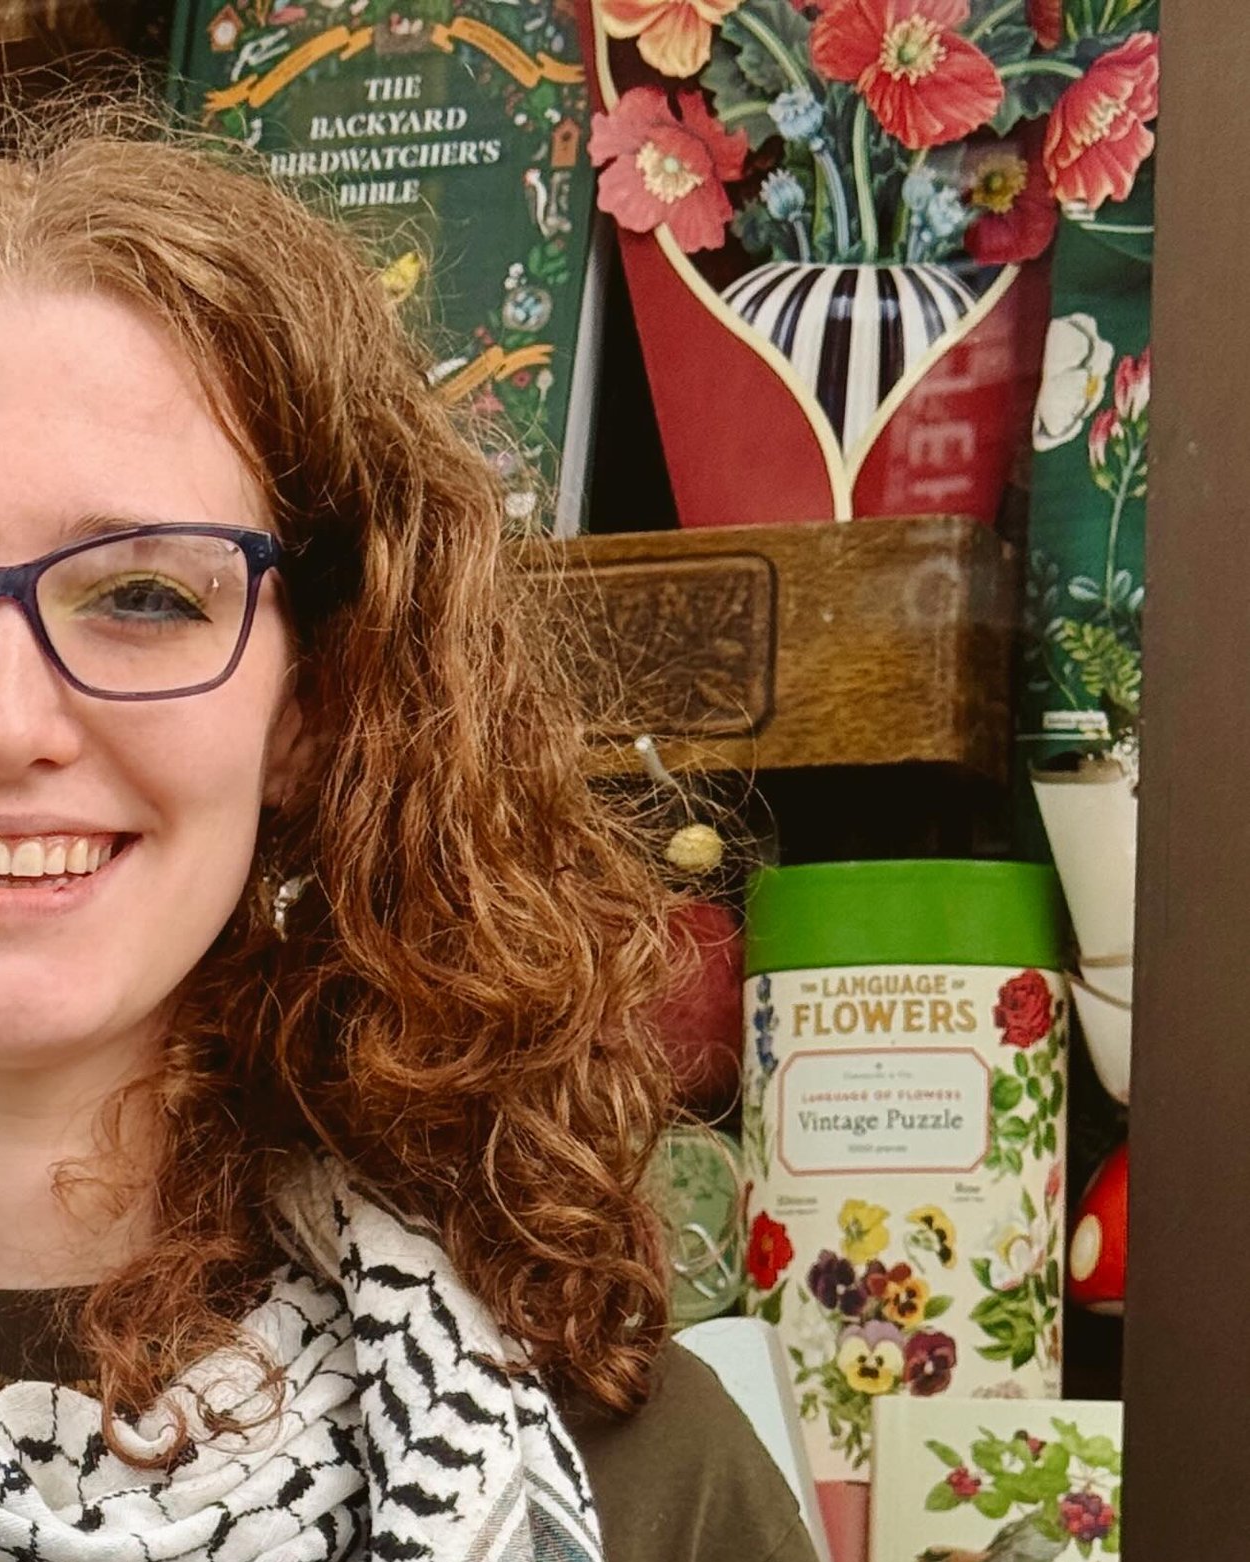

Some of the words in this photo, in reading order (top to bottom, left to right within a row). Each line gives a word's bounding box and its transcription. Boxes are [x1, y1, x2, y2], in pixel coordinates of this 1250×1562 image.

[364, 75, 422, 102] THE
[310, 107, 468, 140] BACKYARD
[270, 139, 501, 176] BIRDWATCHER'S
[340, 179, 421, 207] BIBLE
[822, 974, 948, 997] LANGUAGE
[793, 1000, 977, 1037] FLOWERS
[798, 1109, 879, 1136] Vintage
[886, 1108, 964, 1130] Puzzle
